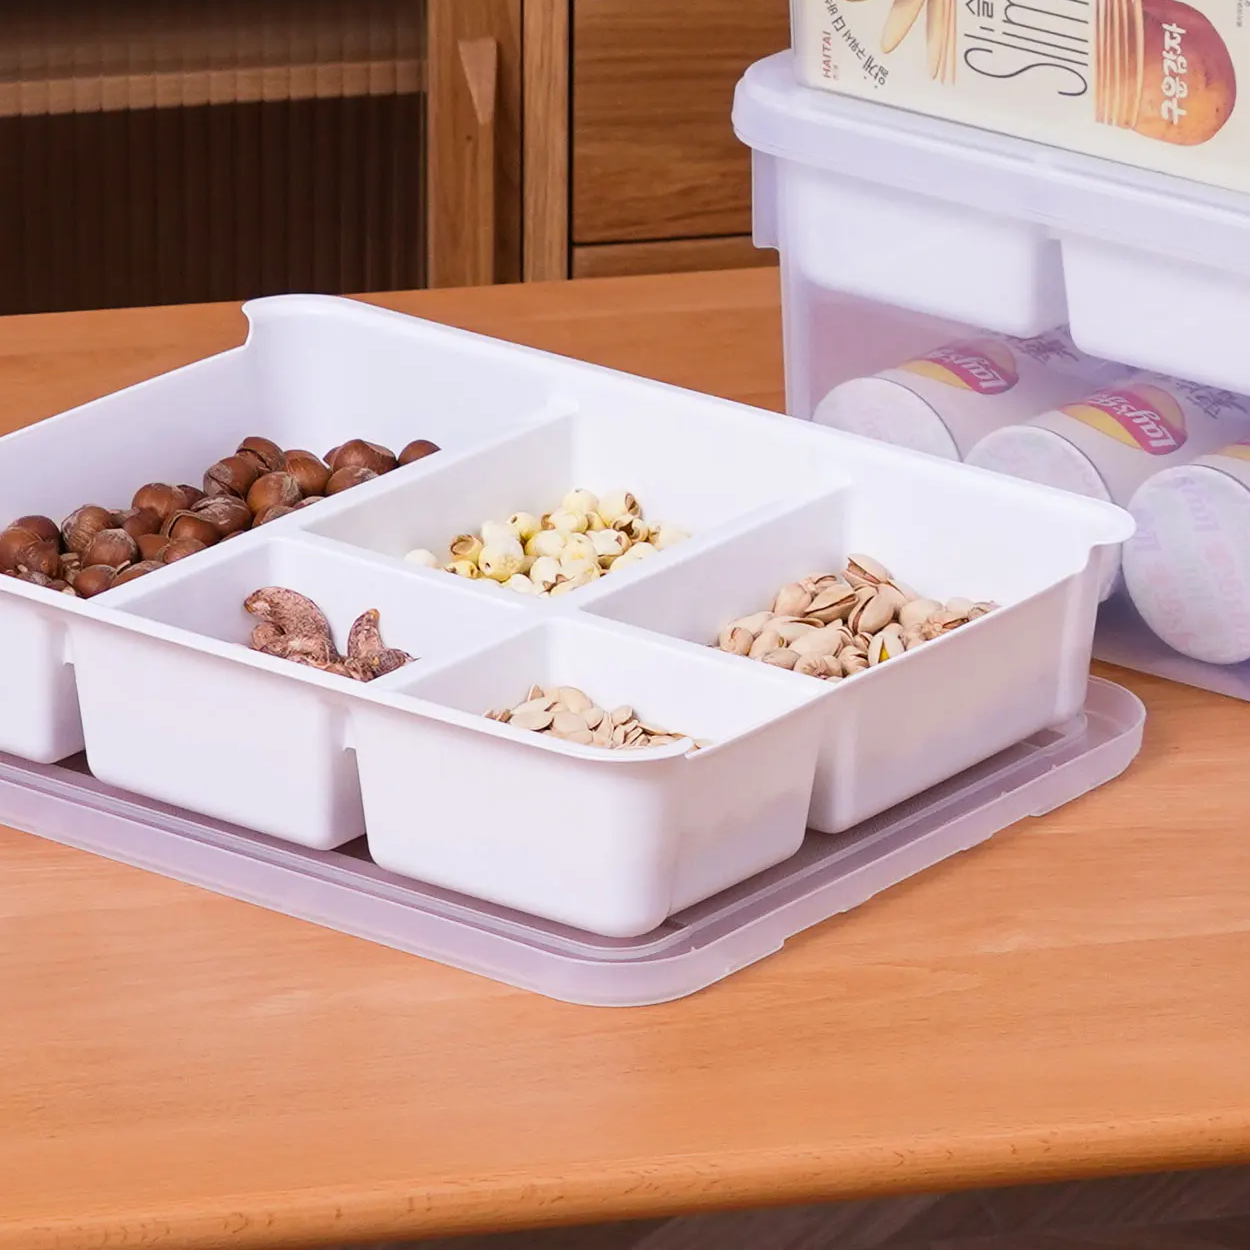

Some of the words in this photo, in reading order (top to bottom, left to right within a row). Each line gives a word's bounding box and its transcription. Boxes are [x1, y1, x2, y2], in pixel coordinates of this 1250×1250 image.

[831, 15, 847, 32] 더
[822, 31, 832, 79] HAITAI
[1161, 22, 1188, 127] 구운감자
